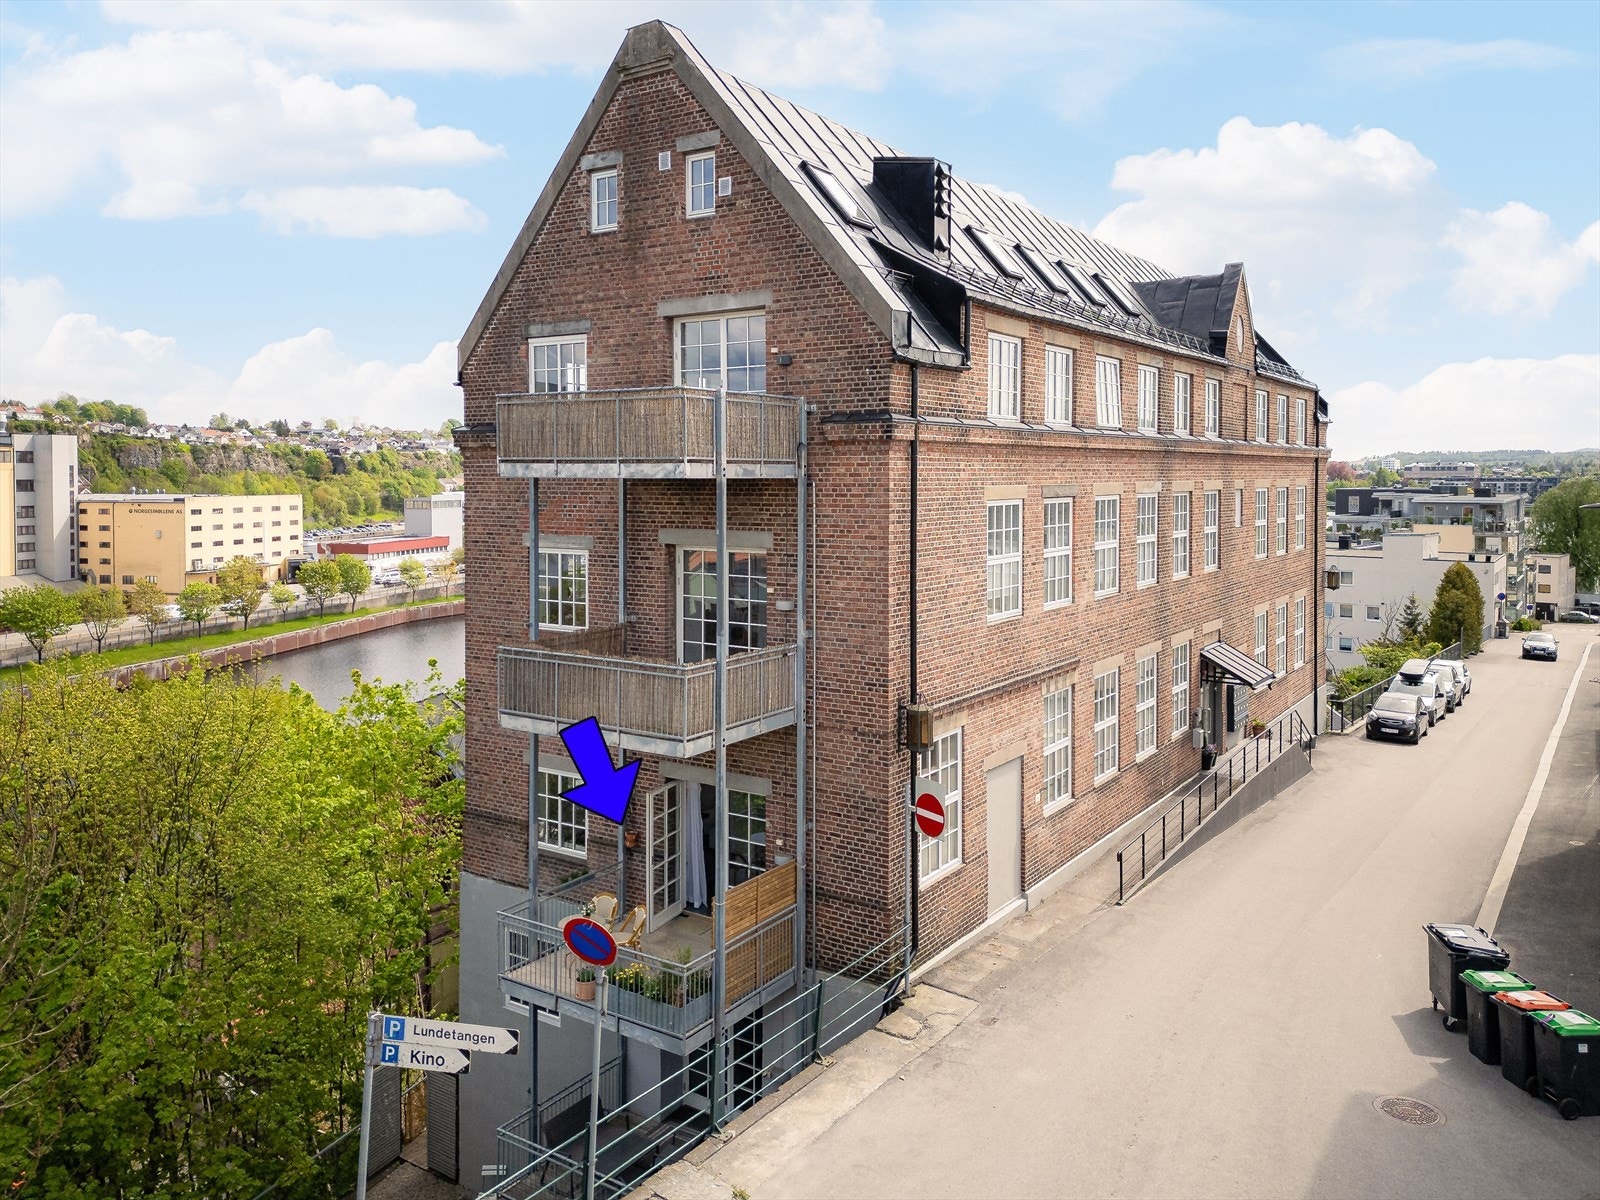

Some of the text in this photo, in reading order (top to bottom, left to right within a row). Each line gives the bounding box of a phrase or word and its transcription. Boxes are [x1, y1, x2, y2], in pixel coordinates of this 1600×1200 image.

[389, 1020, 495, 1045] P Lundetangen
[385, 1045, 445, 1067] P Kino
